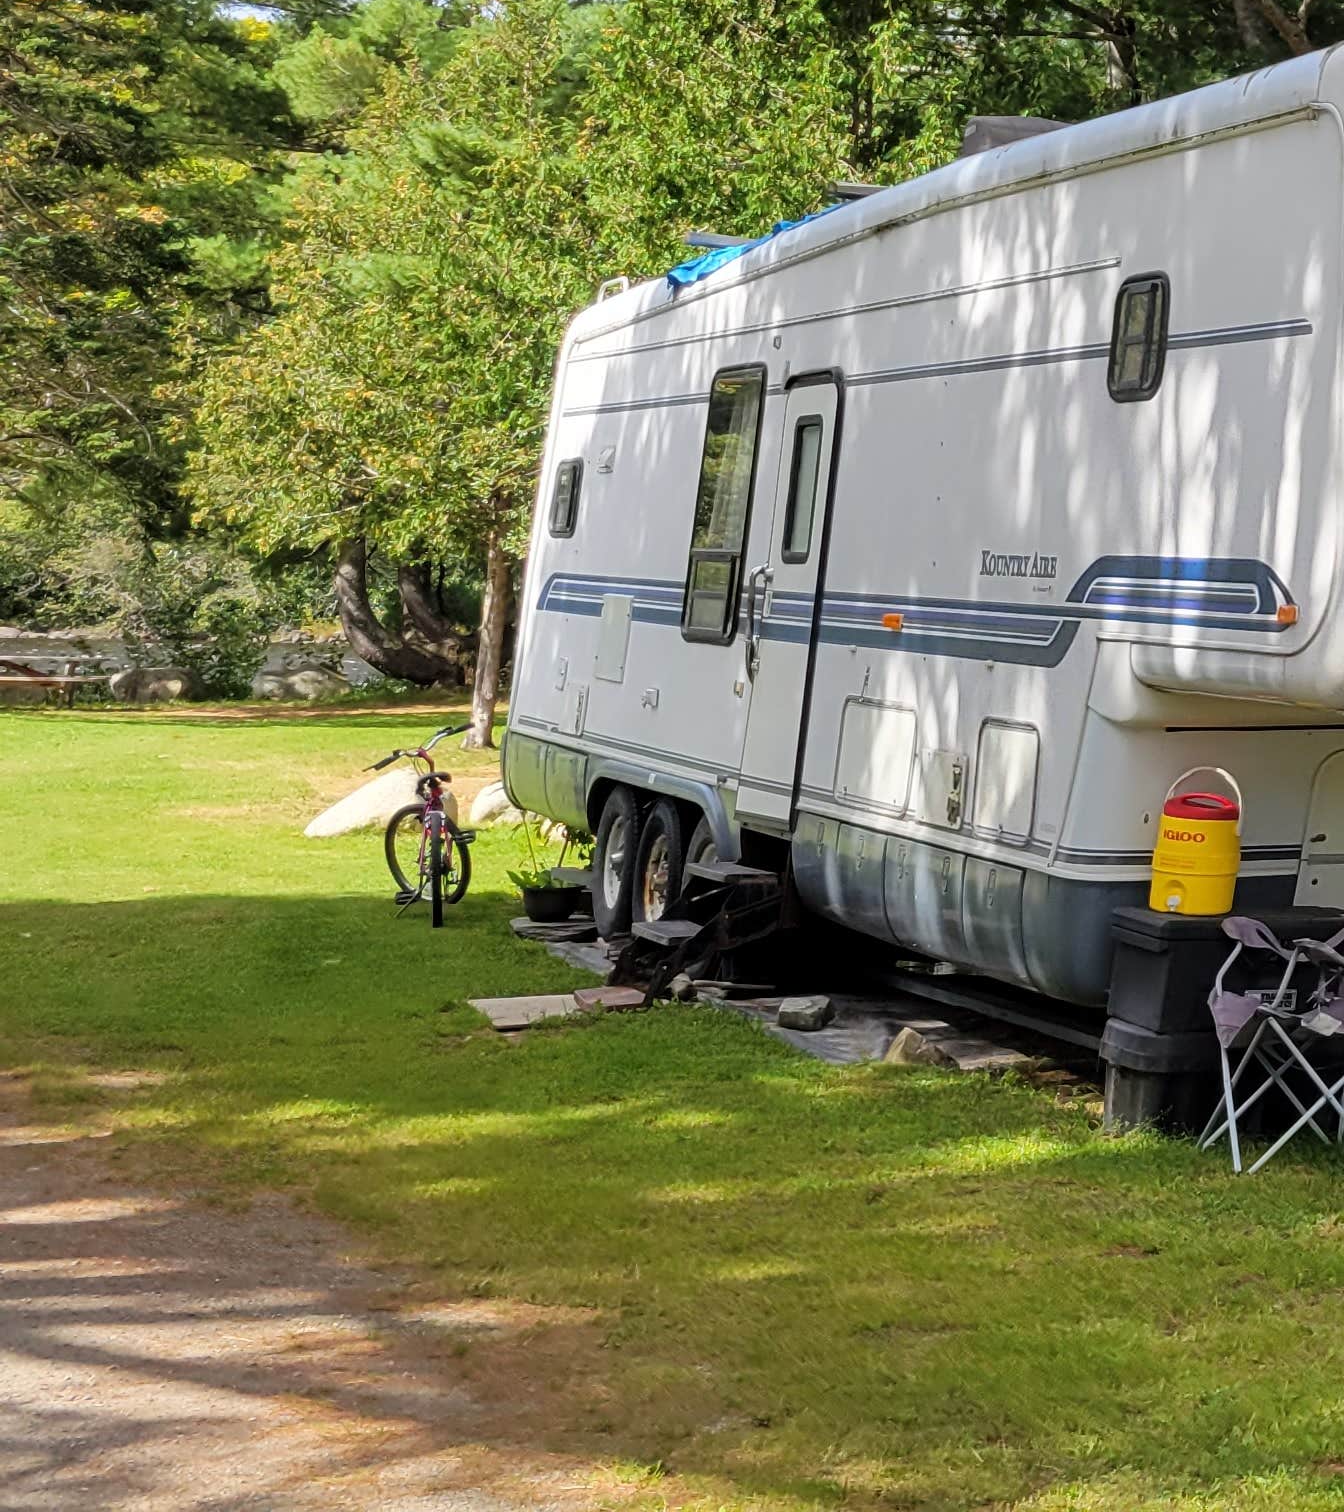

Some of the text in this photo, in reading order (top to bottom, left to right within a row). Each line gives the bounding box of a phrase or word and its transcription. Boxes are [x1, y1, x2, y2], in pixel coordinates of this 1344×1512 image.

[979, 550, 1057, 578] KOUNTRY AIRE
[1163, 829, 1206, 843] IGLOO
